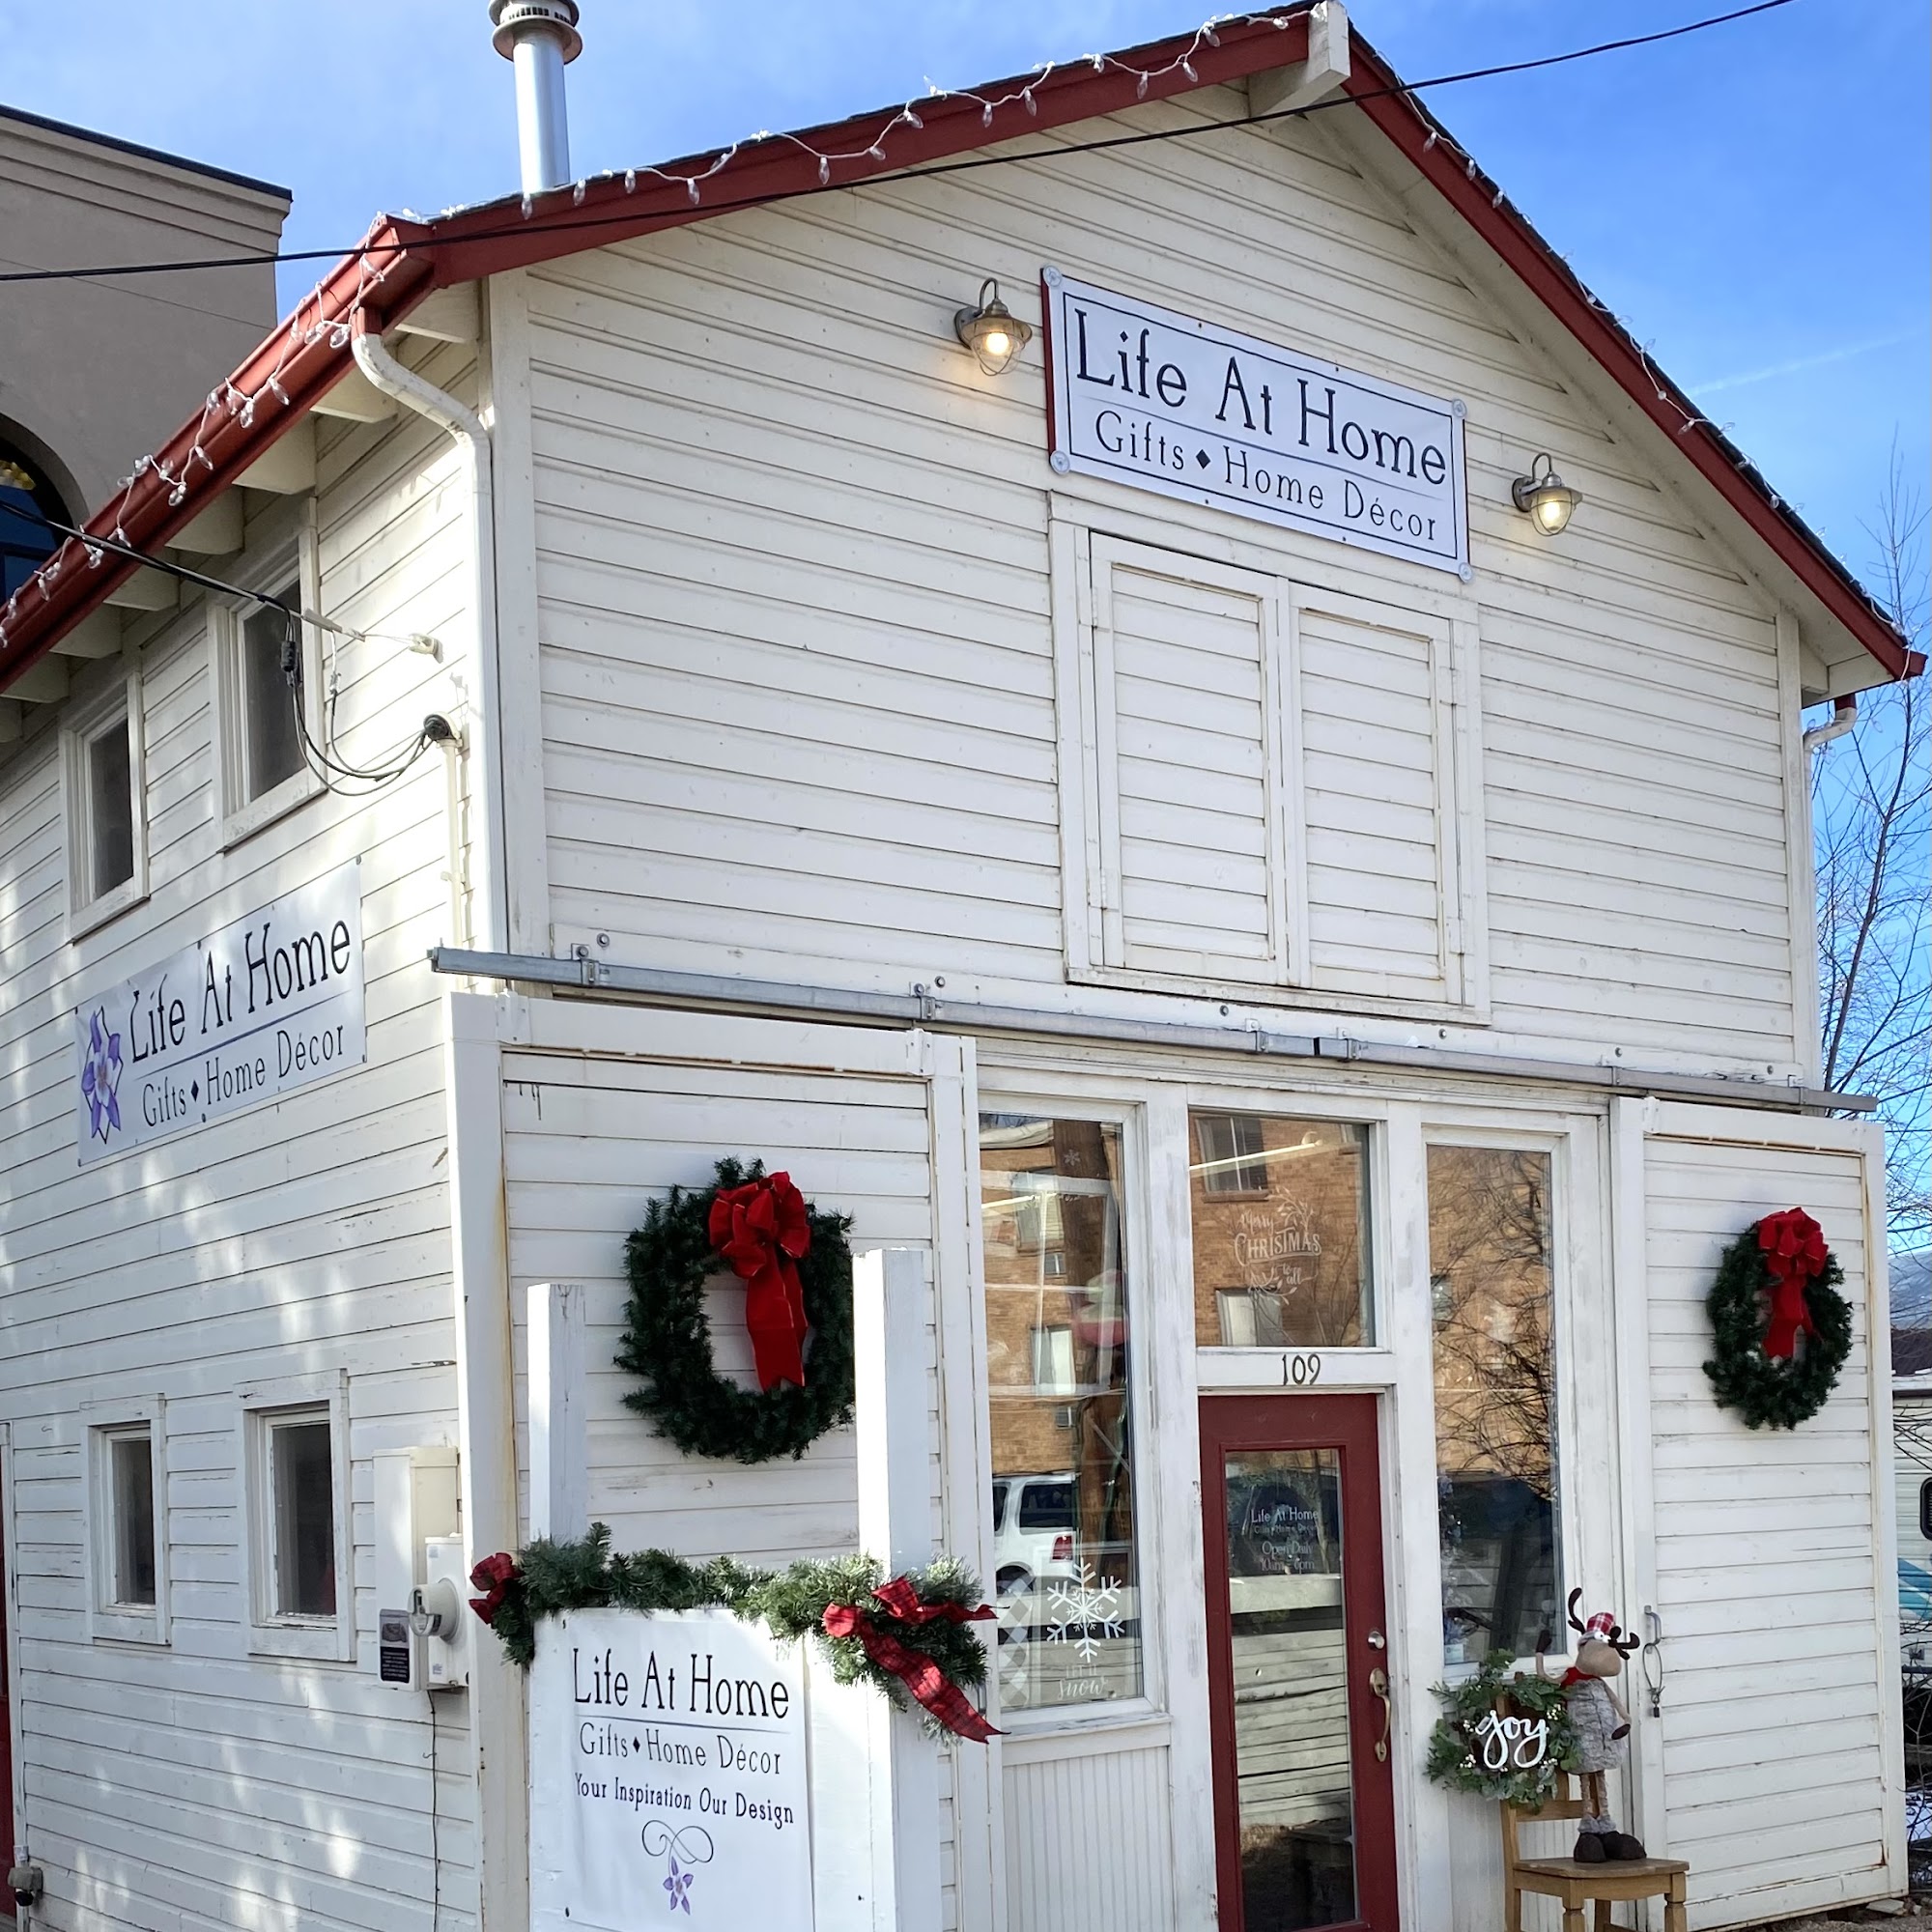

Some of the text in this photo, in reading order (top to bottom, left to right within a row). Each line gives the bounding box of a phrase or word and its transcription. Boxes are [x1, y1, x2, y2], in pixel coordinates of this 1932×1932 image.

[1074, 308, 1446, 485] Life At Home
[1095, 410, 1435, 541] Gifts Home Décor
[129, 920, 351, 1064] Life At Home
[142, 1025, 344, 1127] Gifts Home Décor
[1281, 1353, 1321, 1386] 109
[1251, 1508, 1271, 1523] Life
[1289, 1506, 1320, 1521] Home
[1262, 1541, 1290, 1560] Open
[573, 1648, 789, 1719] Life At Home
[580, 1721, 781, 1775] Gifts Home Décor
[575, 1772, 794, 1830] Your Inspiration Our Design
